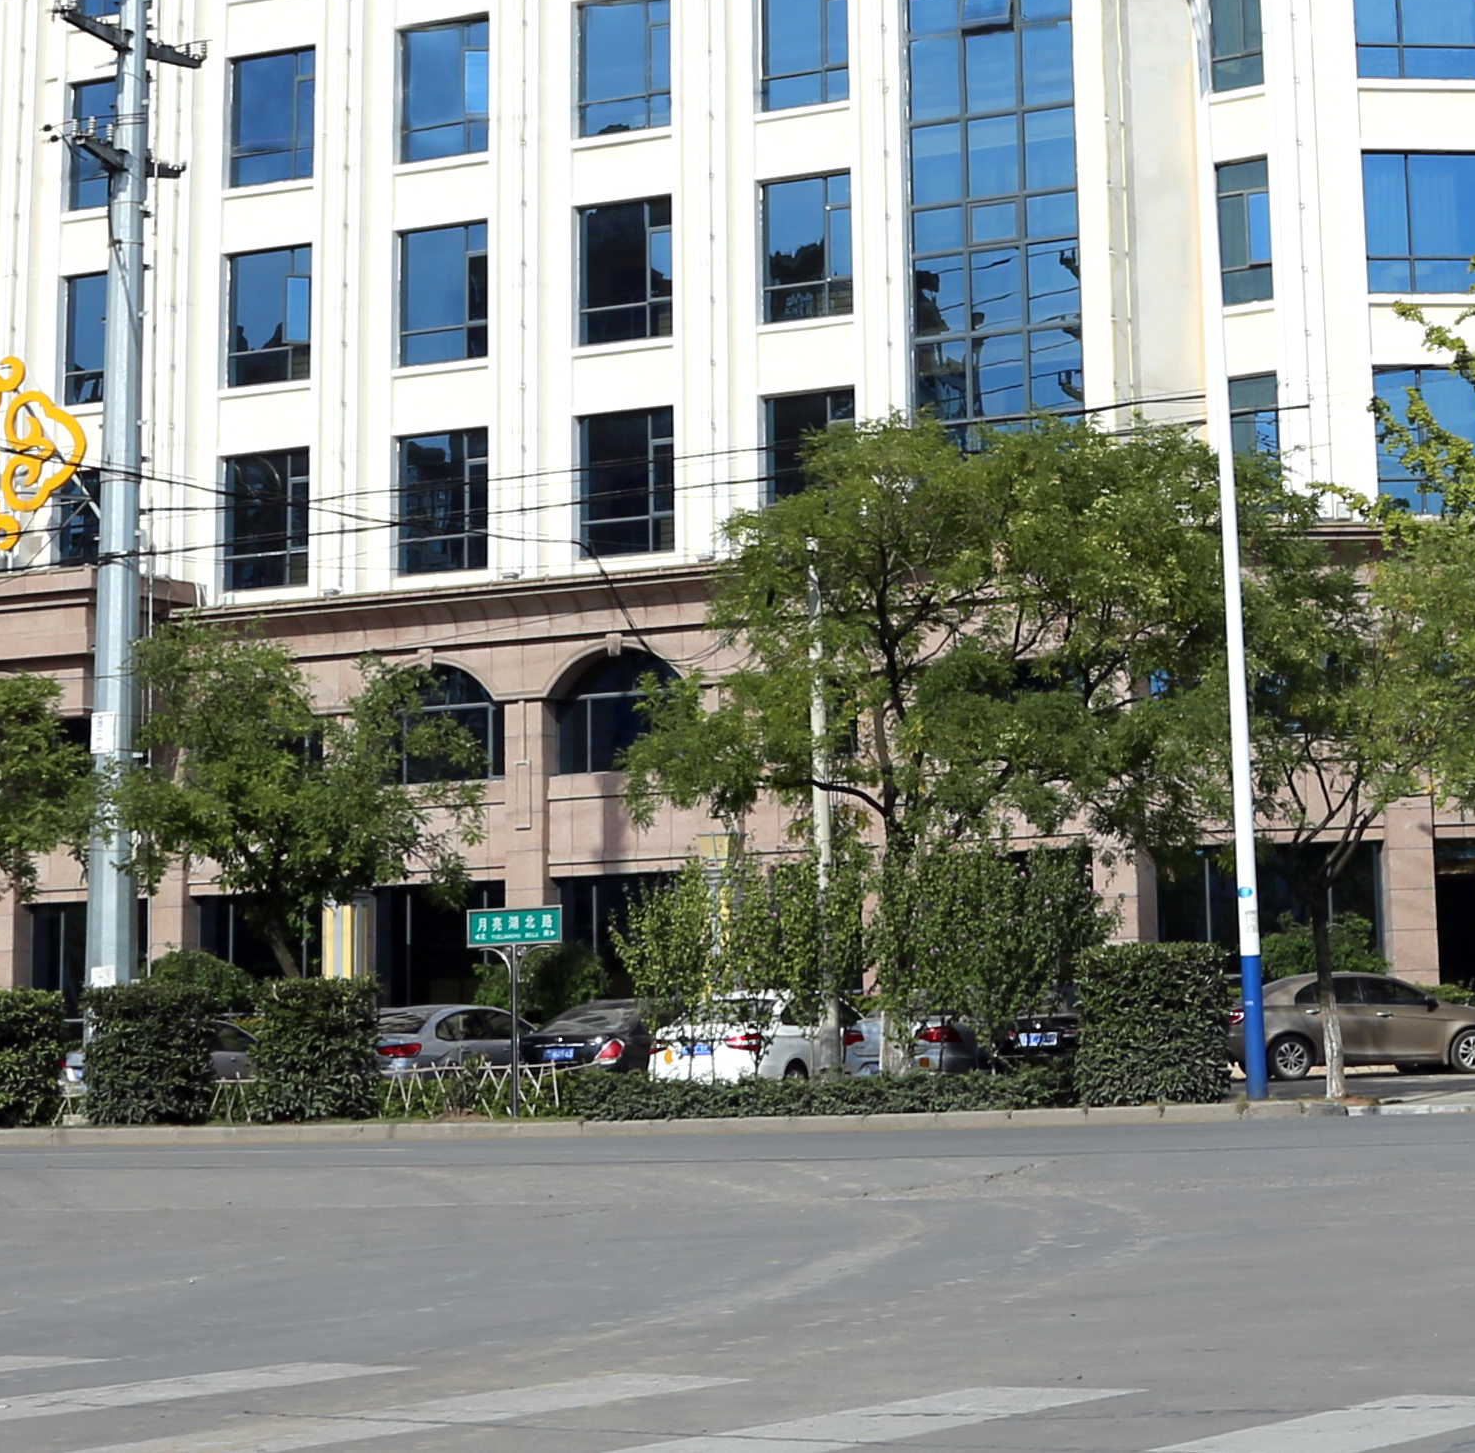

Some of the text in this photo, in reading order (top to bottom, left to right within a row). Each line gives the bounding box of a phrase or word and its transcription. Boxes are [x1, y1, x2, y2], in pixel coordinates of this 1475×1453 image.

[476, 914, 553, 933] 月亮湖北路
